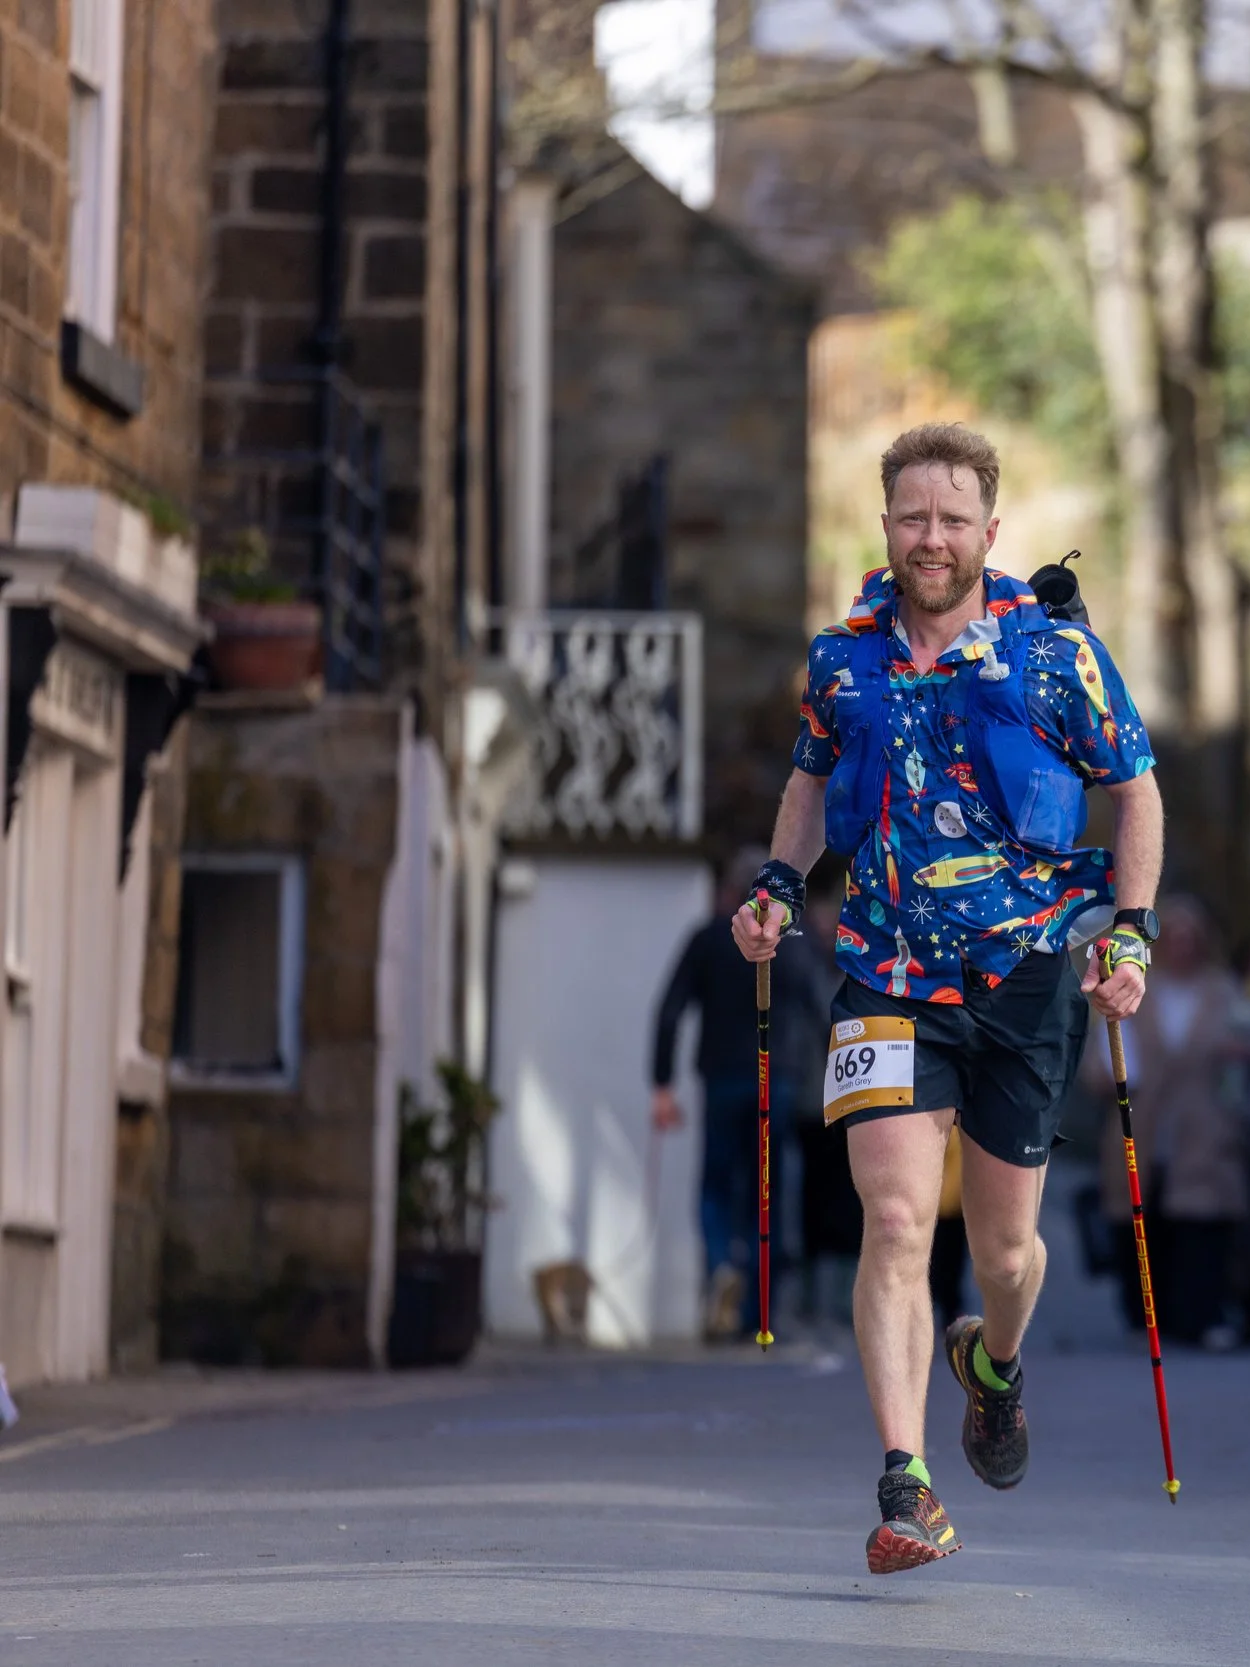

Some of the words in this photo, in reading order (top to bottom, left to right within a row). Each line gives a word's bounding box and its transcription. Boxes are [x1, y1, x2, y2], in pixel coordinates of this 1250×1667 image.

[759, 1057, 767, 1085] LEKI
[834, 1046, 876, 1083] 669
[854, 1076, 872, 1087] Grey
[1125, 1141, 1138, 1173] LEKI
[1133, 1218, 1157, 1328] CARBON
